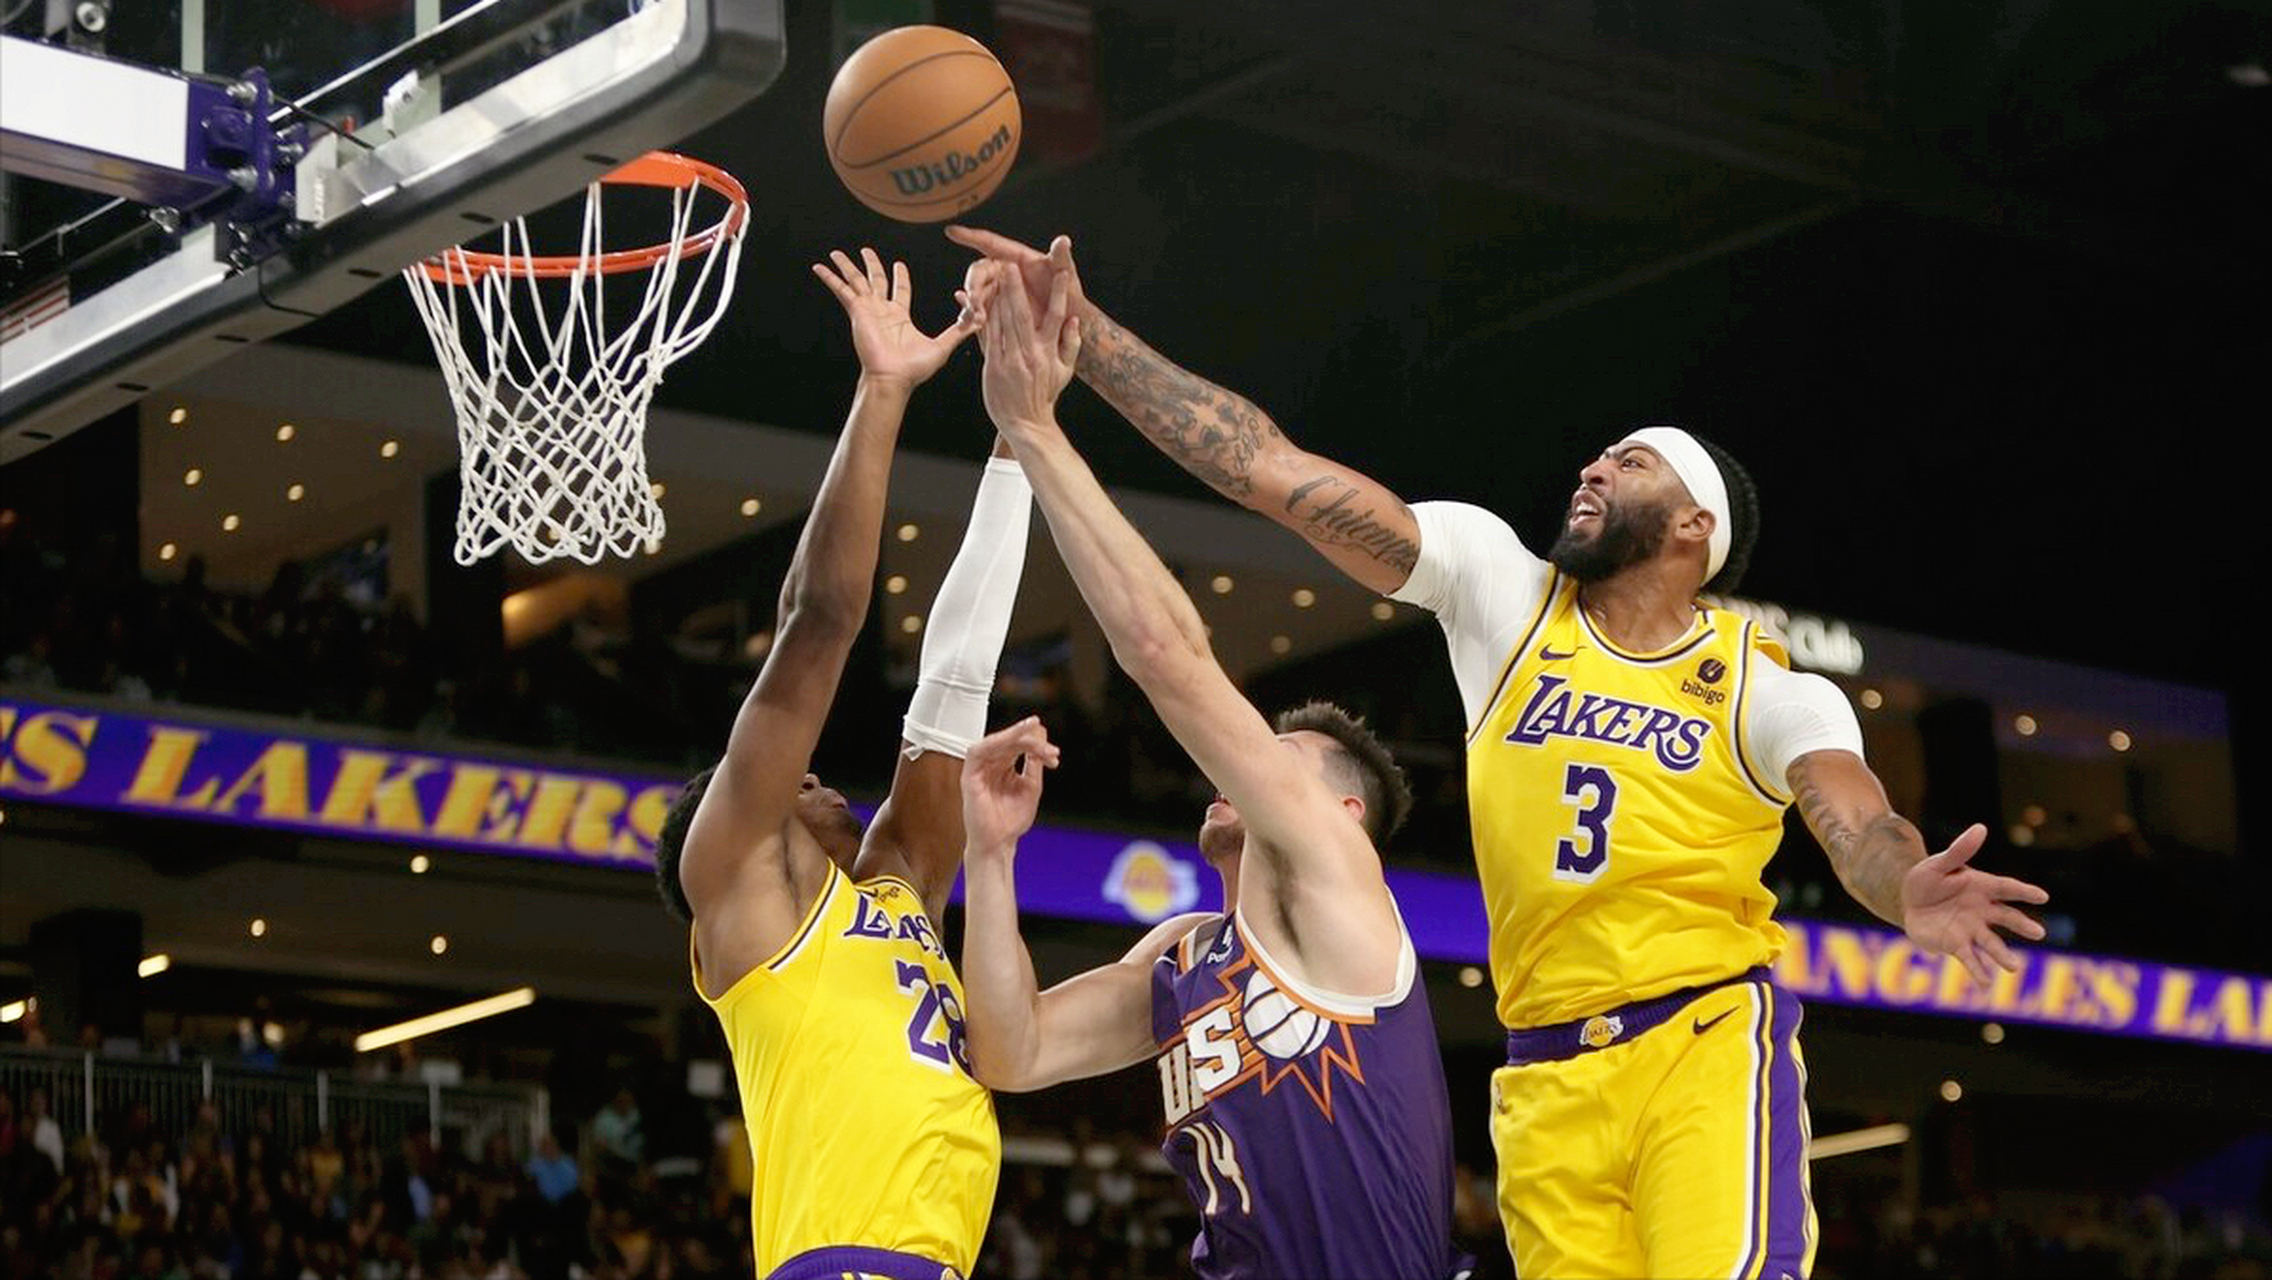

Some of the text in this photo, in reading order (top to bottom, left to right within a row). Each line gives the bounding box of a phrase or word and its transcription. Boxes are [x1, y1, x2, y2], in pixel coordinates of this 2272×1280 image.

[889, 124, 1011, 196] Wilson
[1505, 674, 1713, 772] LAKERS
[1681, 680, 1726, 706] bibigo
[1552, 761, 1619, 884] 3
[2151, 965, 2272, 1047] LA
[1178, 1120, 1251, 1216] 14
